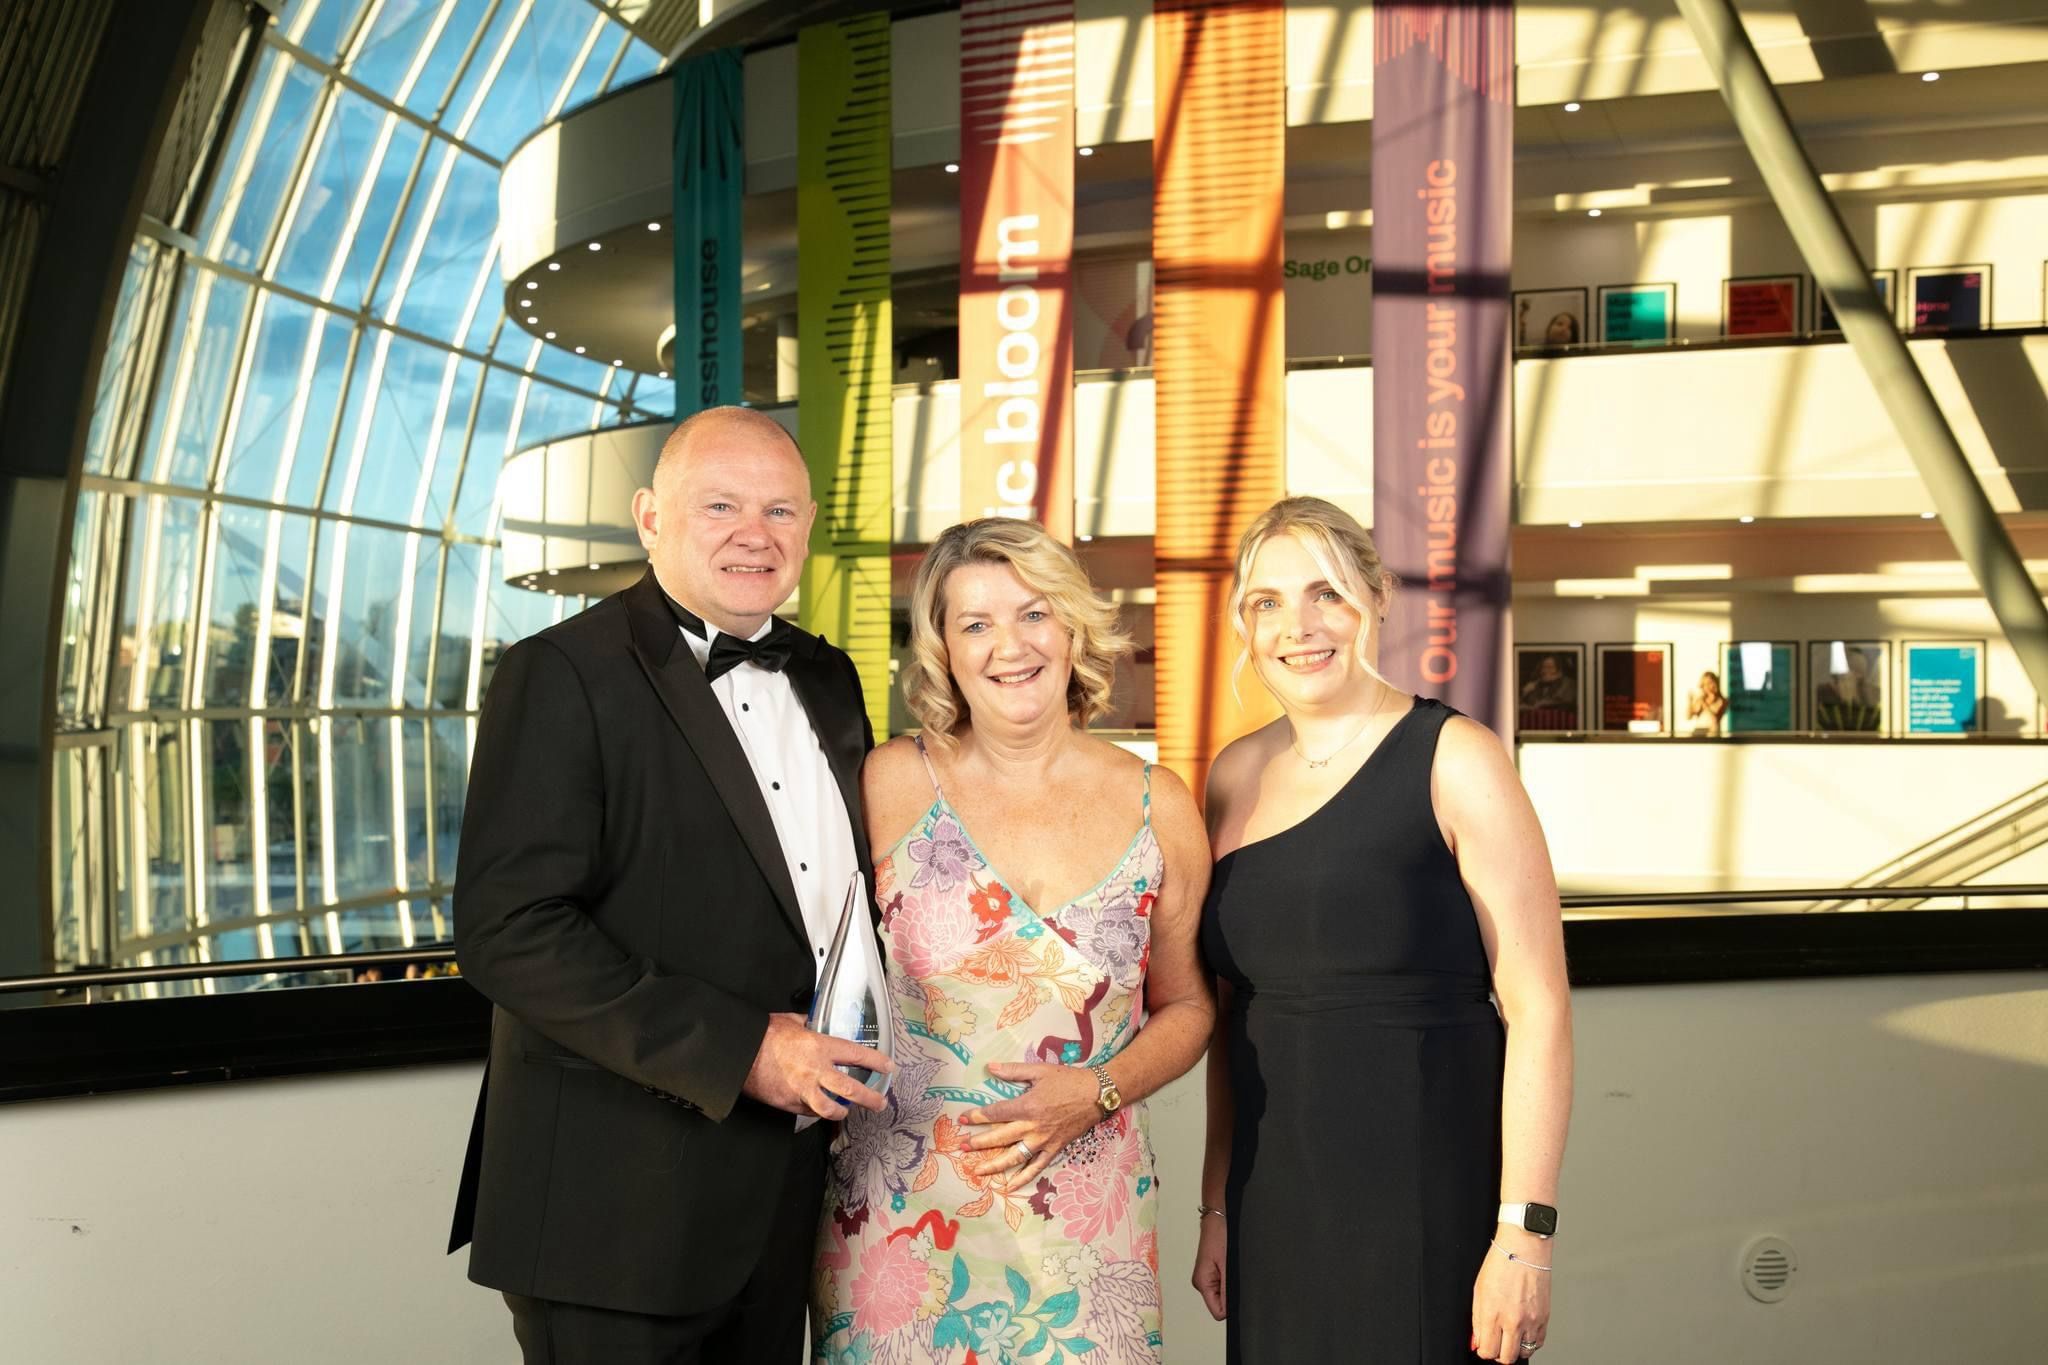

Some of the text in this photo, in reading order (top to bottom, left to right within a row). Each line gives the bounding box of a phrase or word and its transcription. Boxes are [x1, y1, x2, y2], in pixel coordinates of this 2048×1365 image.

[984, 215, 1039, 444] bloom
[1284, 259, 1340, 281] Sage
[1418, 160, 1465, 684] Our music is your music
